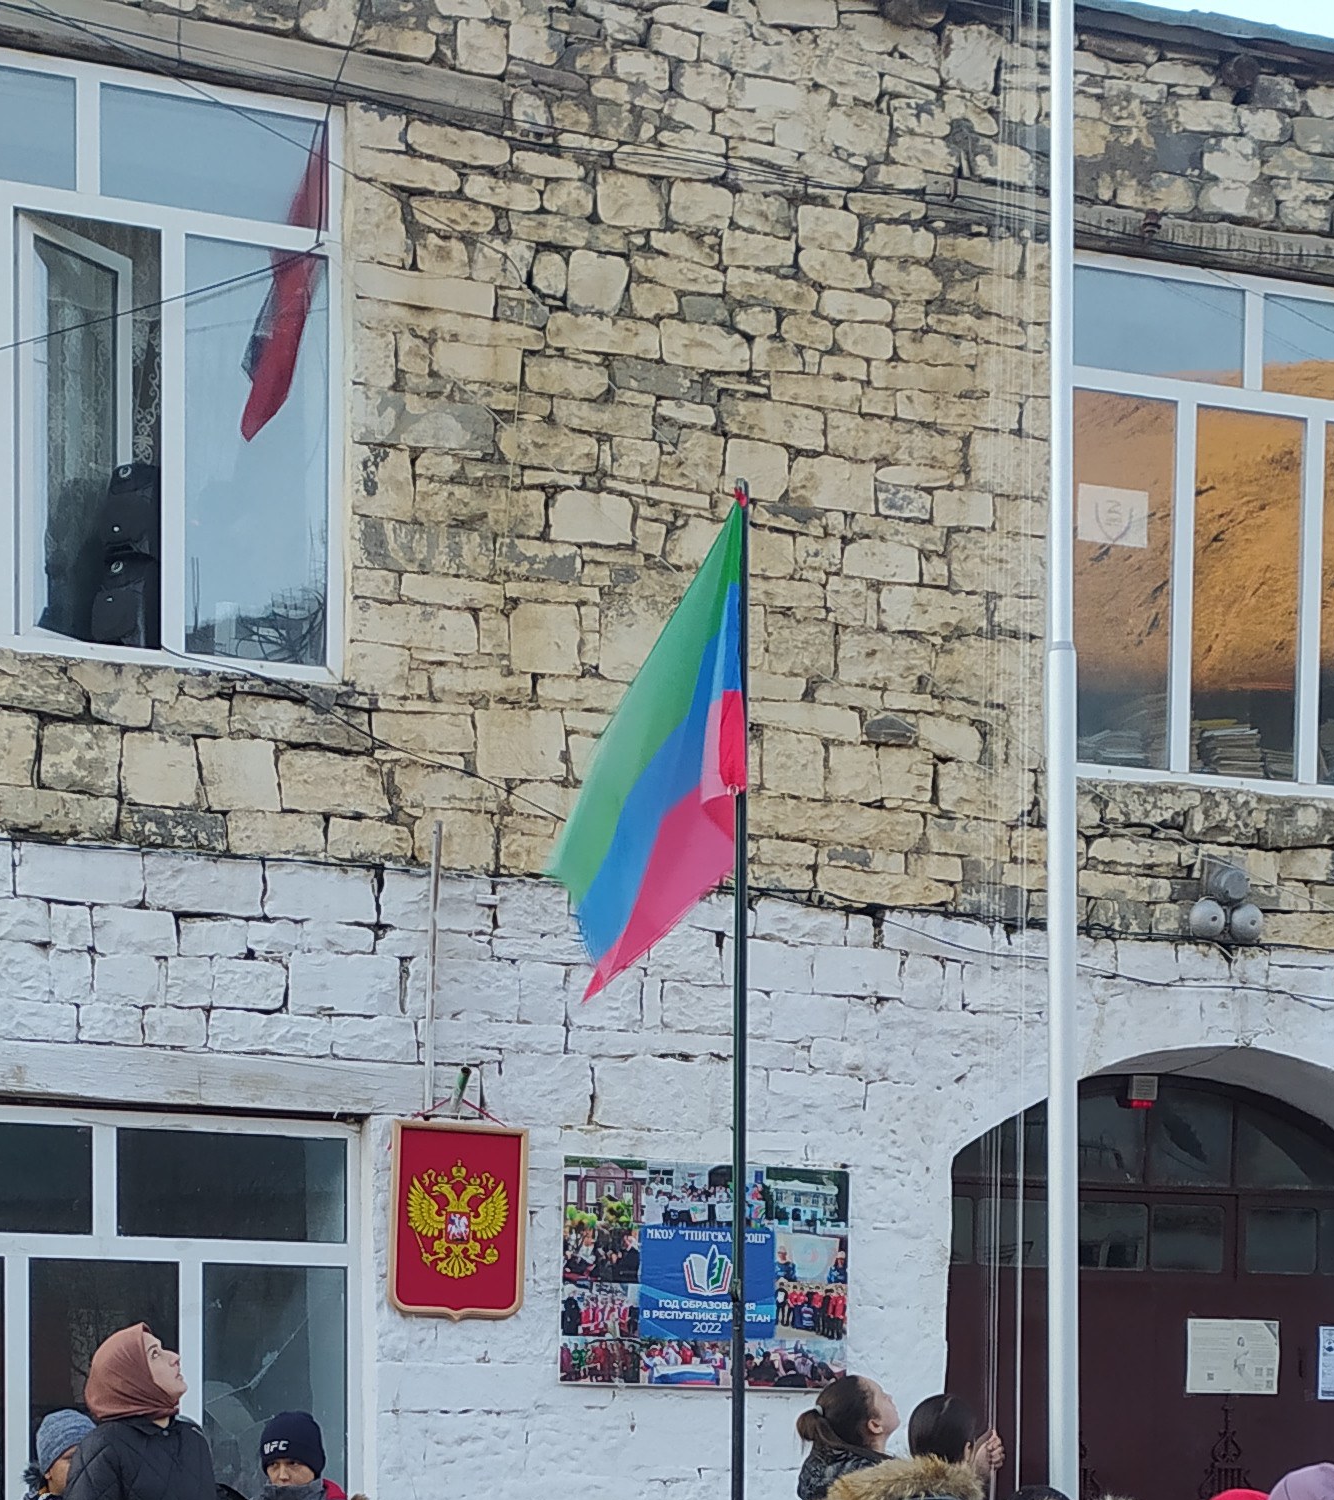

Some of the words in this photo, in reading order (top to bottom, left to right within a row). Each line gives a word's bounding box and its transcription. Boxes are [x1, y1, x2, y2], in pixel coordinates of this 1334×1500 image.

[646, 1228, 676, 1239] МКОУ
[679, 1230, 733, 1242] "ТПИГСКА
[659, 1299, 679, 1309] ГОД
[681, 1301, 756, 1310] ОБРАЗОВАИЯ
[643, 1310, 650, 1318] В
[652, 1310, 717, 1320] РЕСПУБЛИКЕ
[719, 1313, 771, 1322] ДАСТАН
[691, 1322, 722, 1333] 2022
[264, 1441, 289, 1454] UFC
